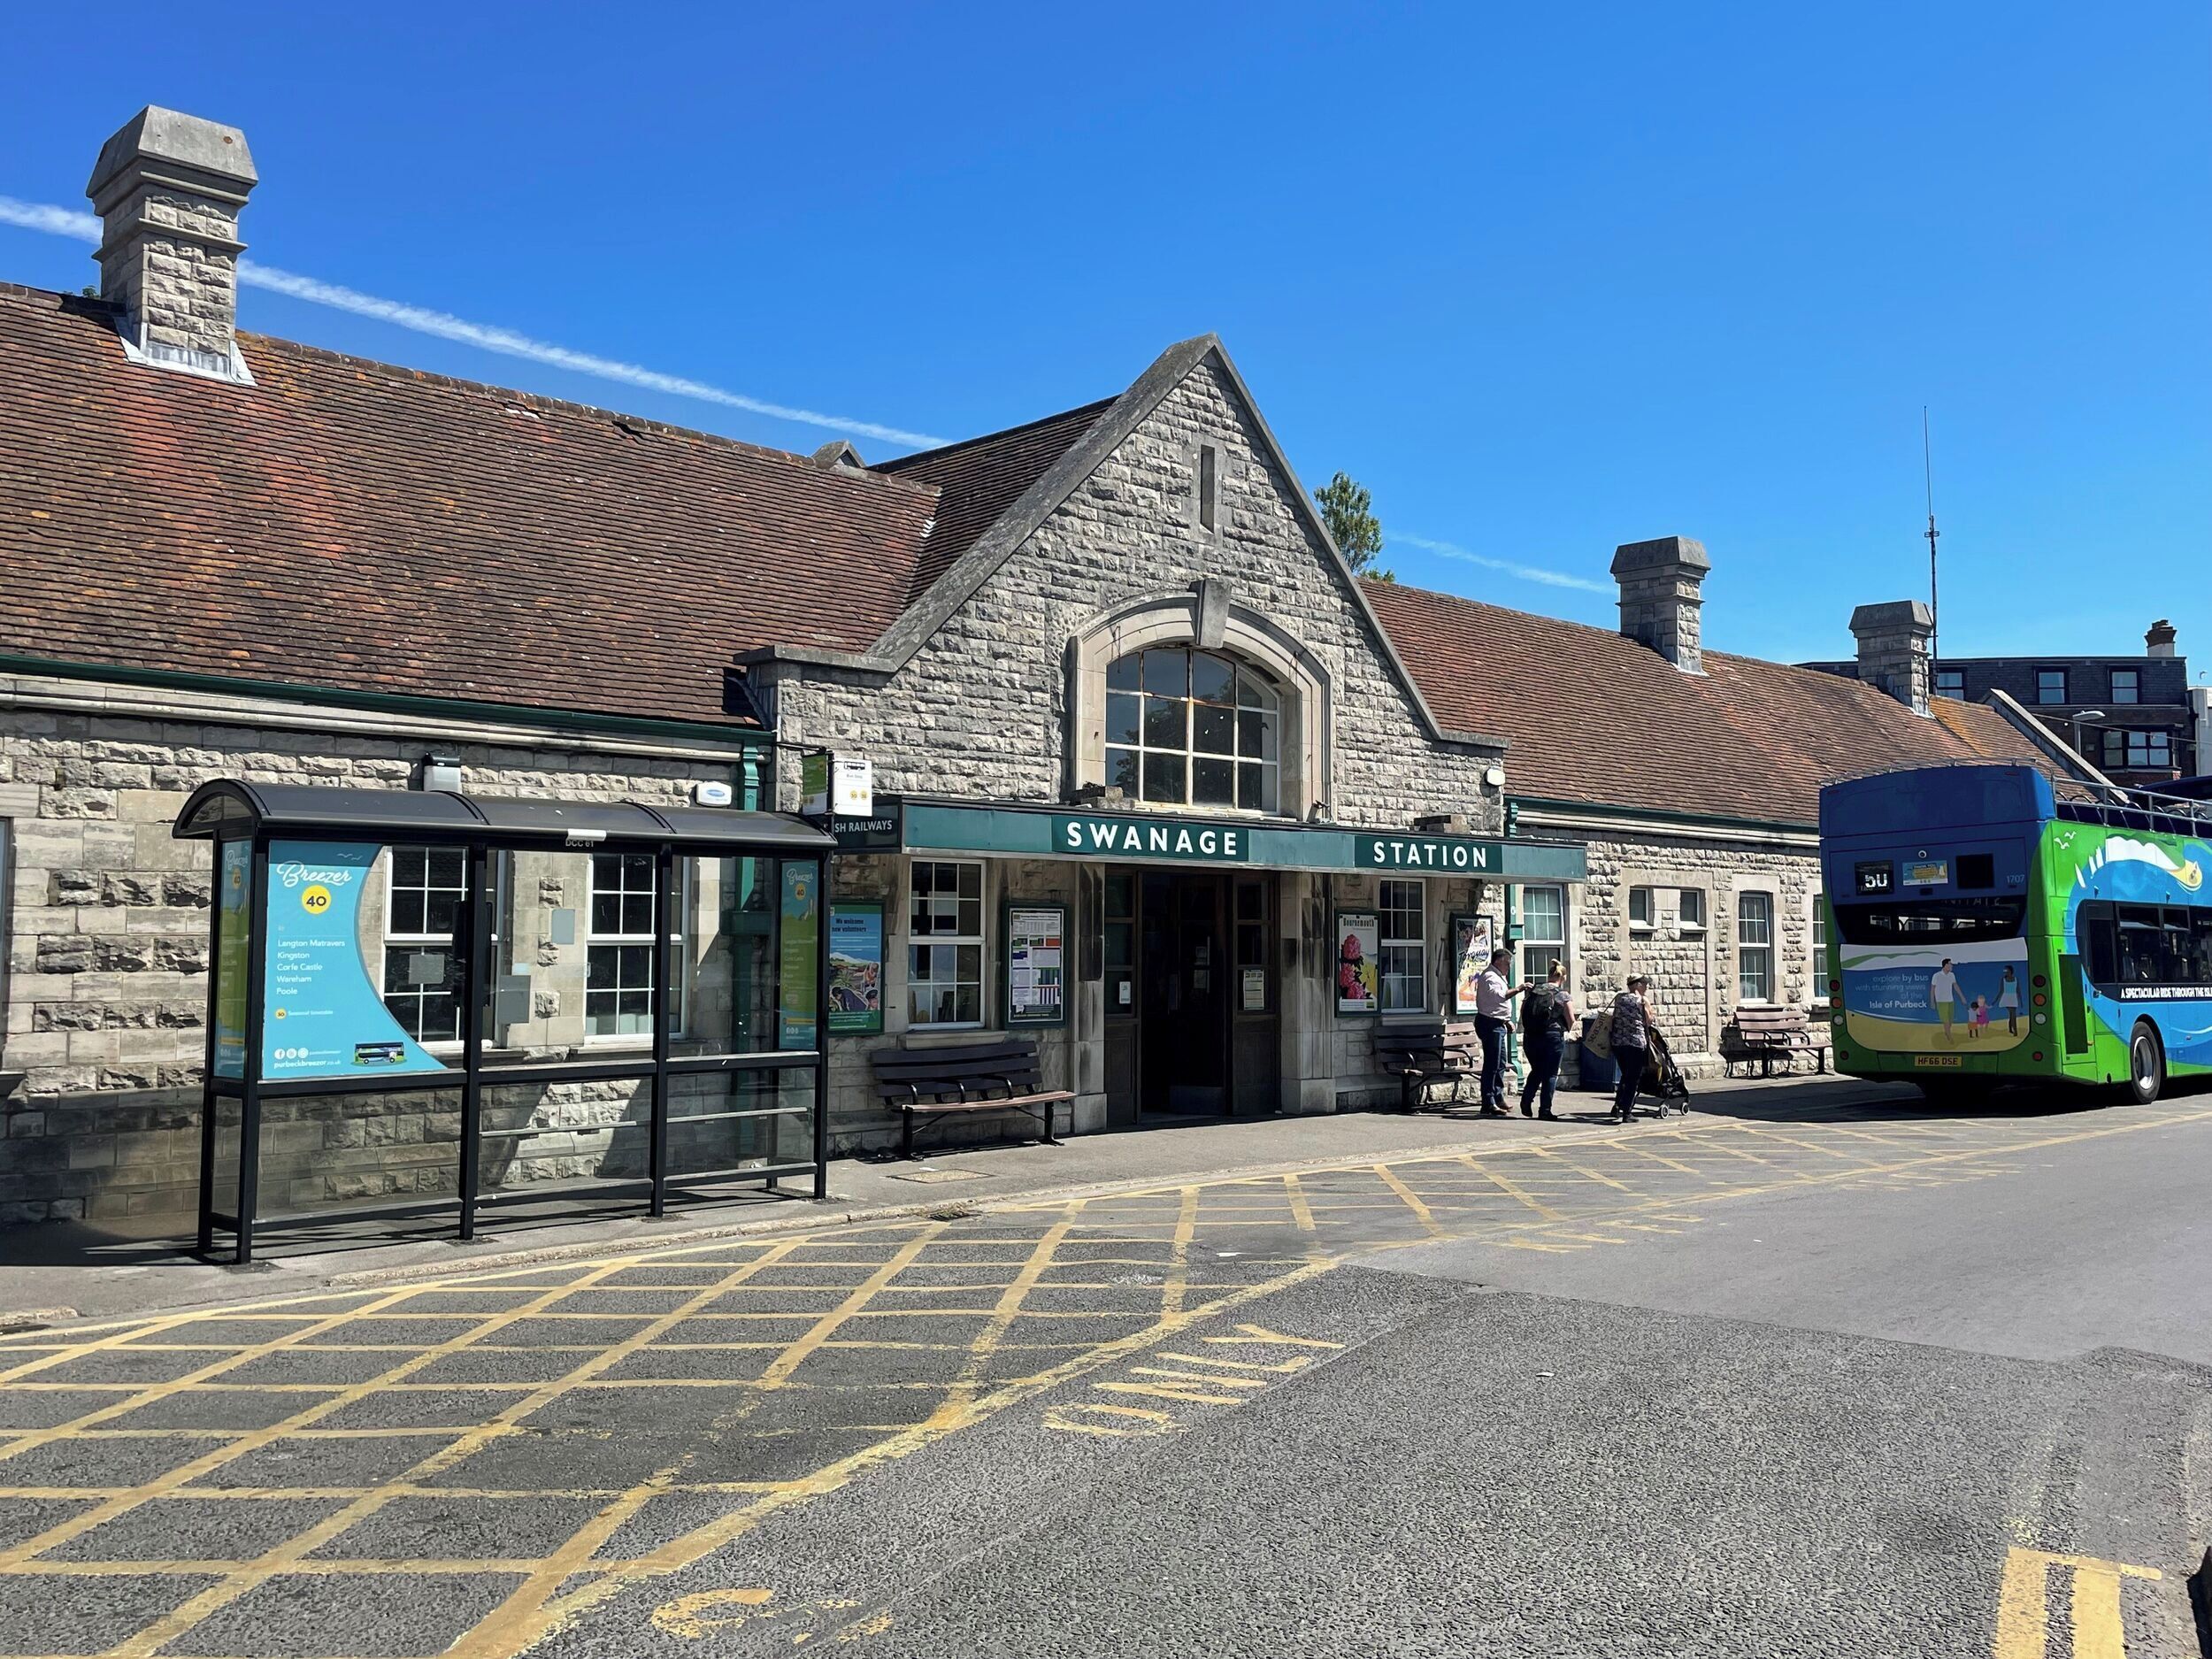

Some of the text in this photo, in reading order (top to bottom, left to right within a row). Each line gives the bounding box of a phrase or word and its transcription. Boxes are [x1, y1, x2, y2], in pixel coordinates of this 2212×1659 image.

[849, 819, 893, 832] RAILWAYS
[1067, 821, 1237, 856] SWANAGE
[1373, 841, 1486, 868] STATION
[277, 860, 352, 888] Breezer
[2007, 874, 2025, 884] 1707
[306, 895, 327, 907] 40
[278, 940, 308, 949] Langton
[1902, 974, 1912, 983] by
[276, 987, 298, 995] Poole
[1871, 983, 1904, 992] stunning
[2121, 988, 2125, 998] A
[2125, 987, 2160, 998] SPECTACULAR
[2171, 987, 2194, 997] THROUGH
[2194, 987, 2204, 997] THE
[1917, 1056, 1958, 1065] HF66 DSE
